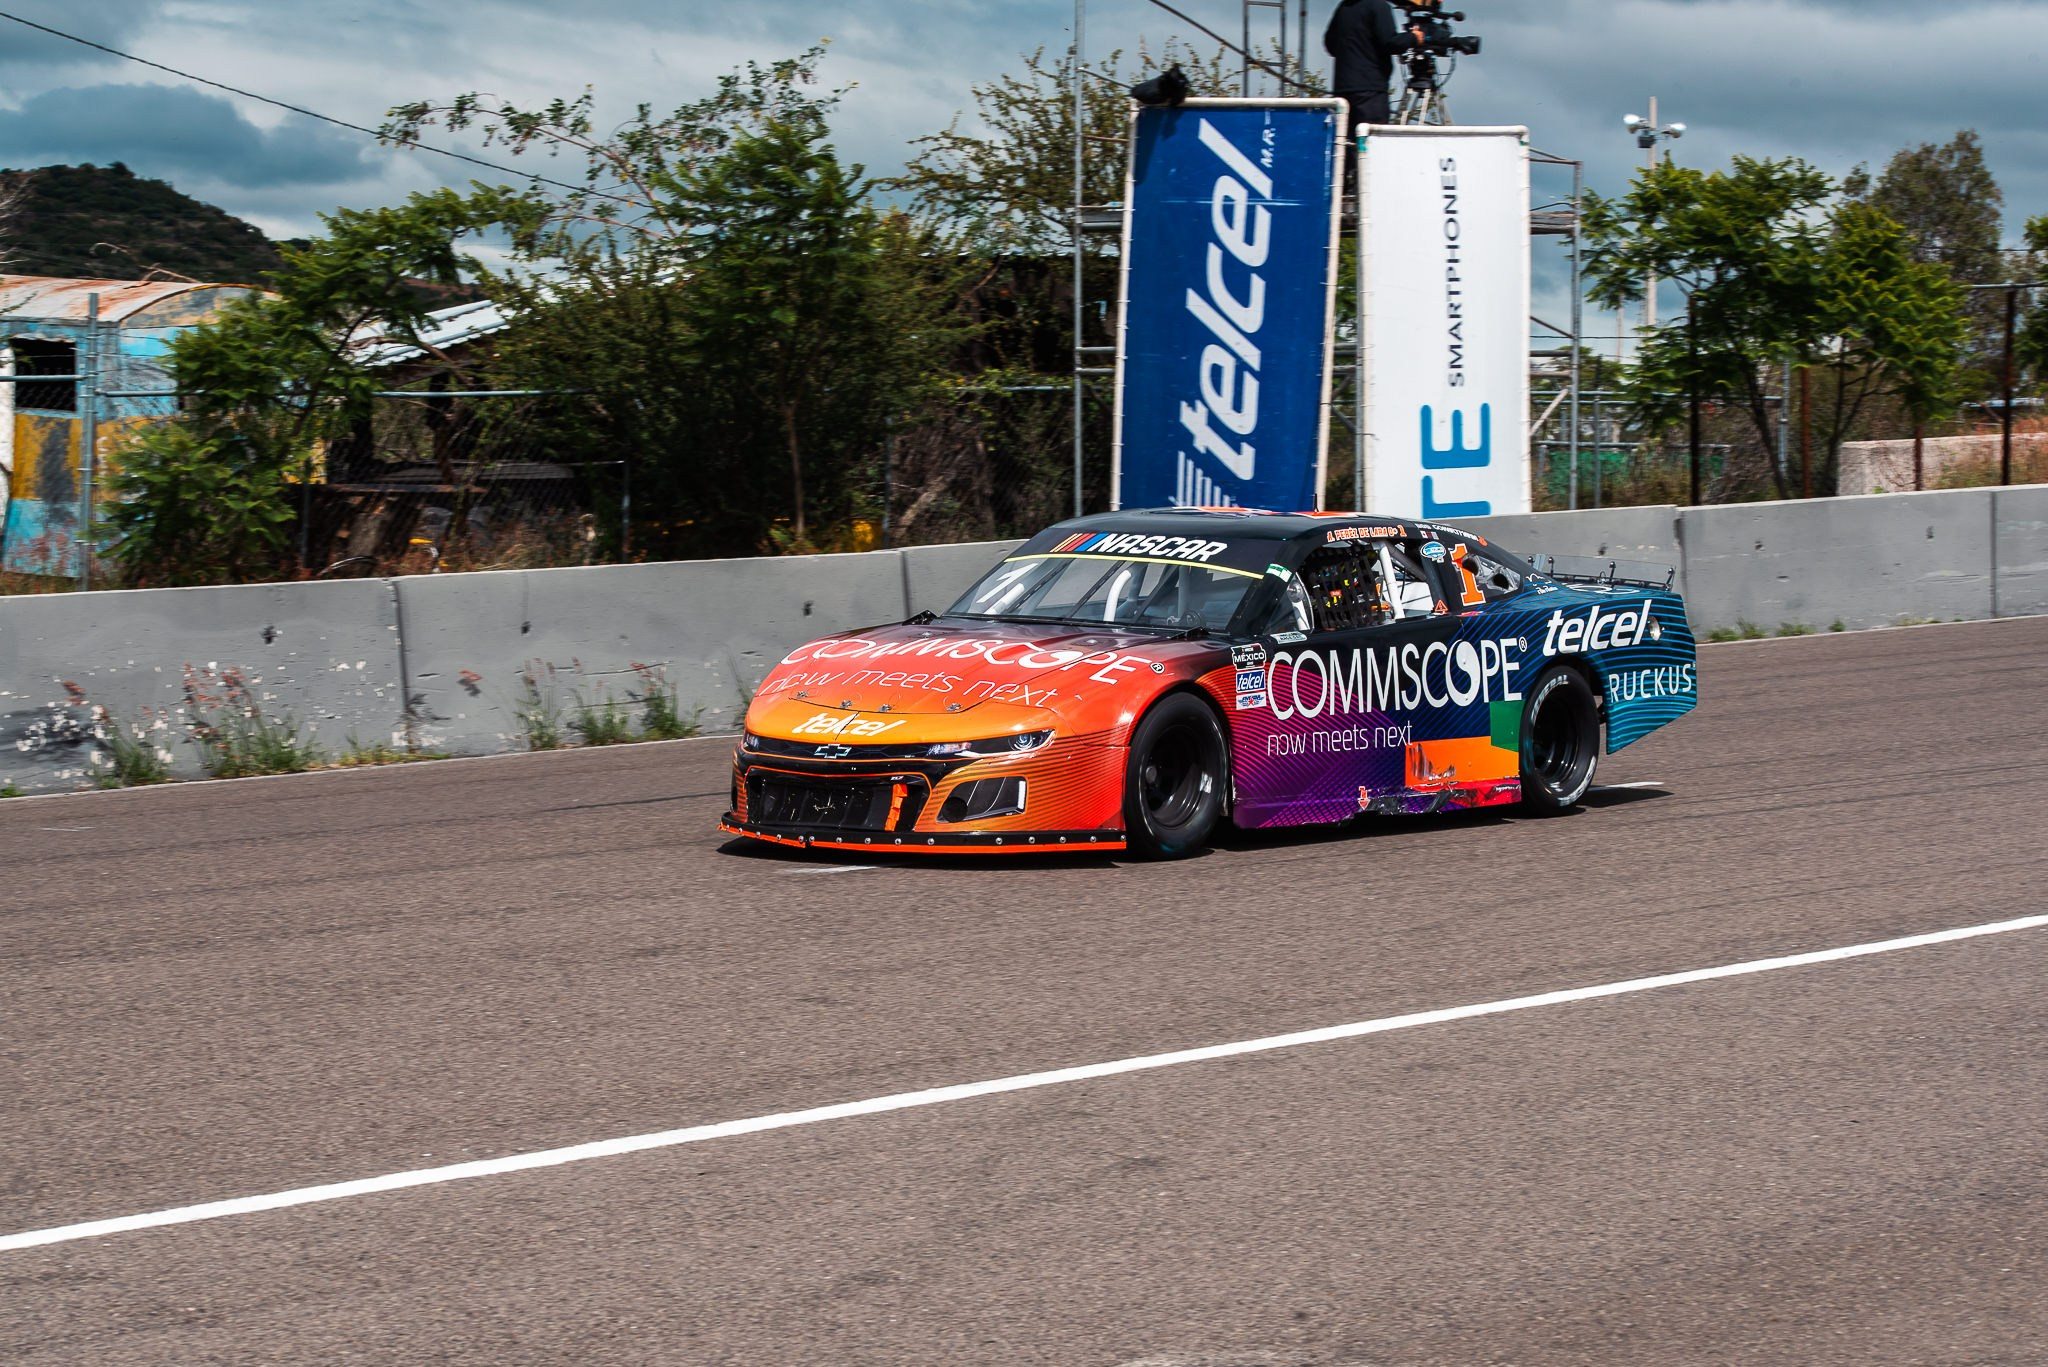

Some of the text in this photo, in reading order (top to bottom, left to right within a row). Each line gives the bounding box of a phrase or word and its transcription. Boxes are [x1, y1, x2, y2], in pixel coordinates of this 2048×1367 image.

[1439, 156, 1466, 388] SMARTPHONES
[1180, 117, 1273, 482] telcel
[1087, 533, 1228, 562] NASCAR
[1358, 527, 1369, 538] DE
[1369, 526, 1388, 538] LARA
[1450, 543, 1487, 607] 1
[1542, 599, 1653, 658] telcel
[759, 668, 1059, 709] now meets next
[1237, 671, 1265, 691] telcel
[1608, 664, 1692, 703] RUCKUS
[791, 712, 908, 738] telcel
[1267, 720, 1414, 757] now meets next
